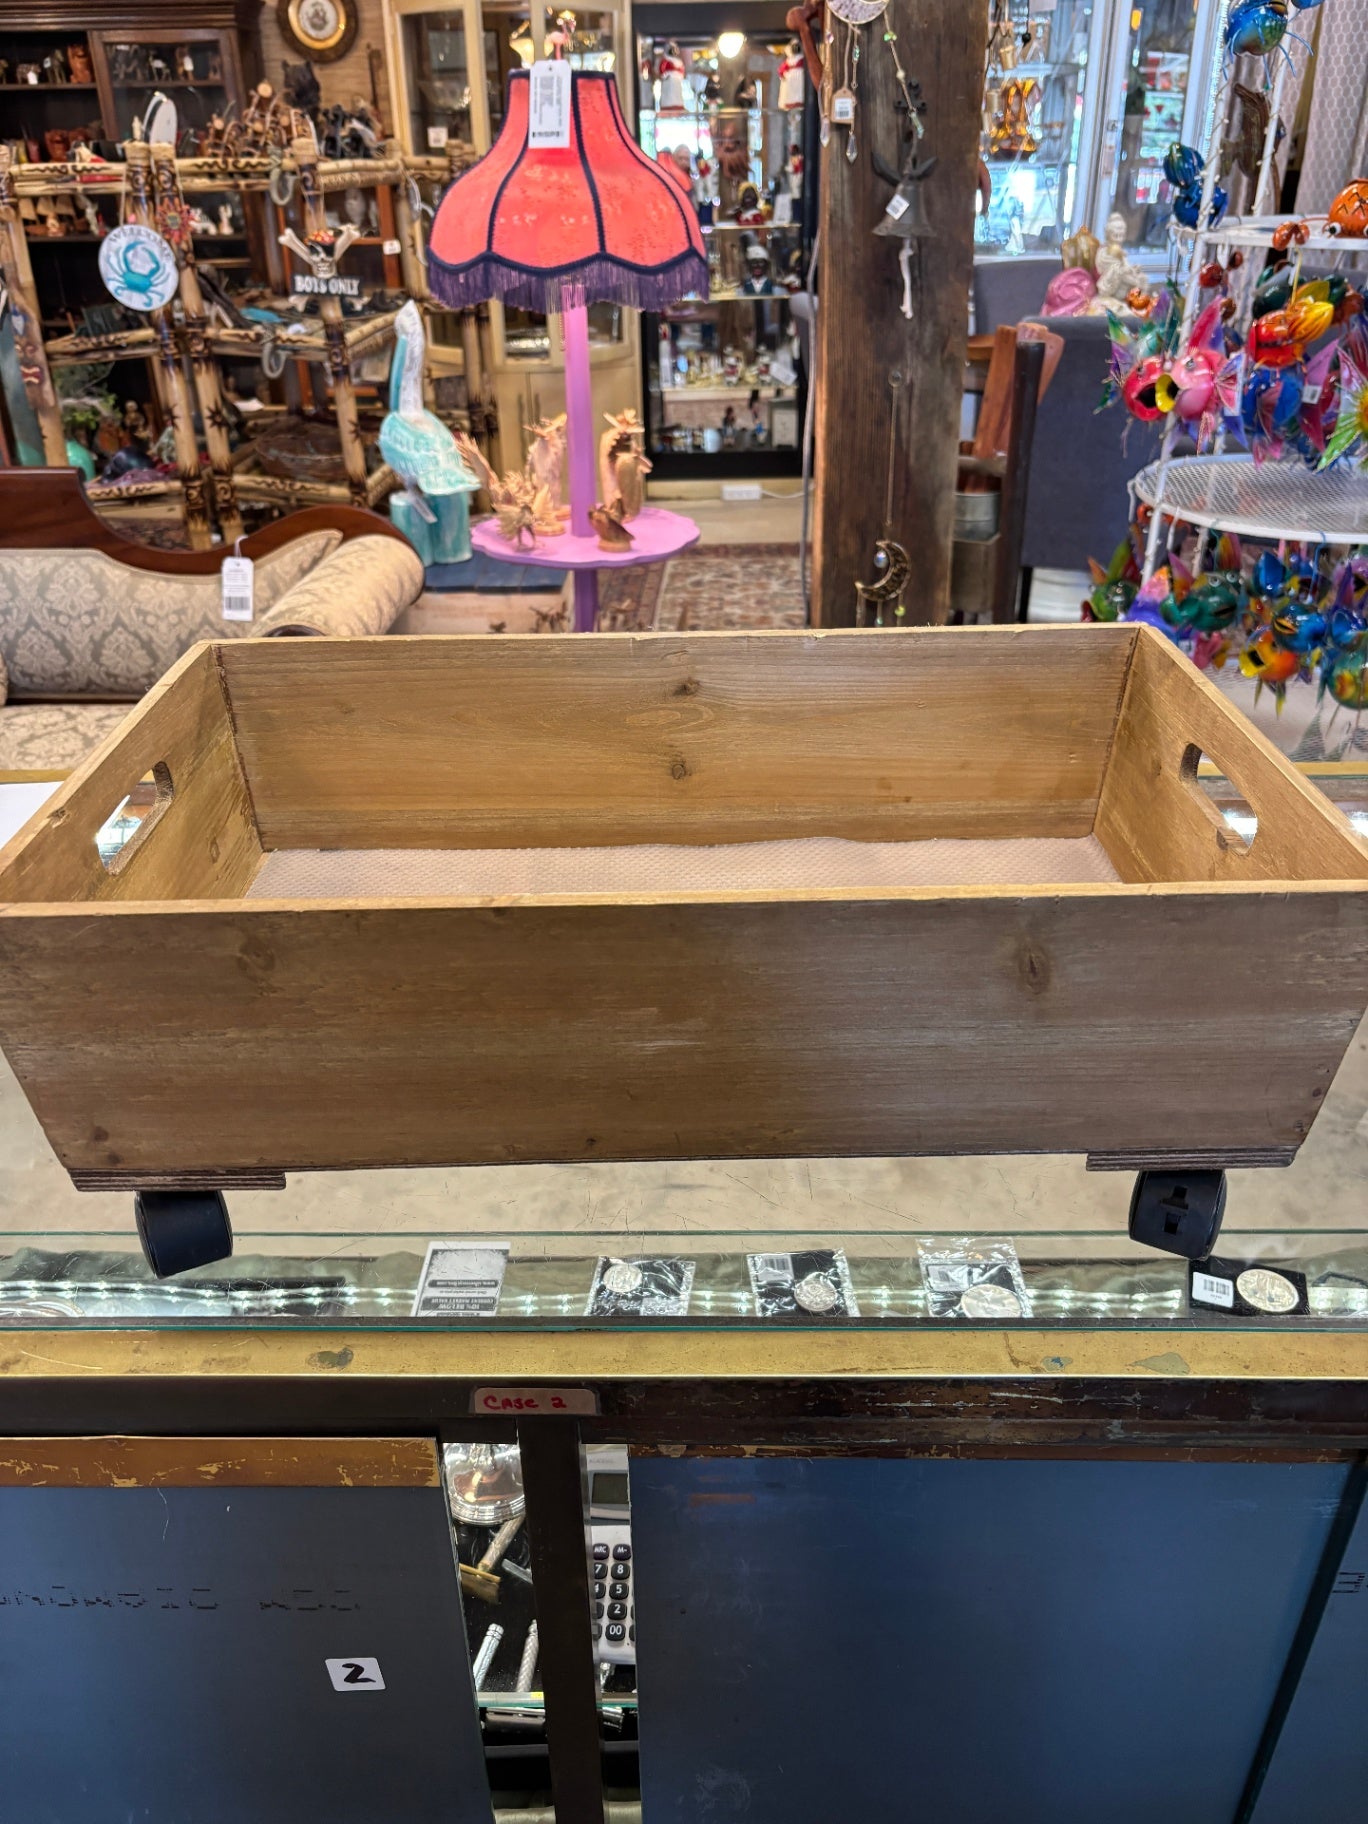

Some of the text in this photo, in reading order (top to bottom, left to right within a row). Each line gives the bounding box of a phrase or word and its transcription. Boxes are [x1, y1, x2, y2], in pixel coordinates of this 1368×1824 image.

[294, 275, 360, 296] BOYS ONLY
[550, 1396, 568, 1409] 2
[595, 1563, 602, 1574] 7
[617, 1564, 624, 1574] 8
[616, 1584, 623, 1594] 5
[613, 1603, 621, 1614] 2
[609, 1624, 623, 1635] 00
[341, 1662, 377, 1684] 2
